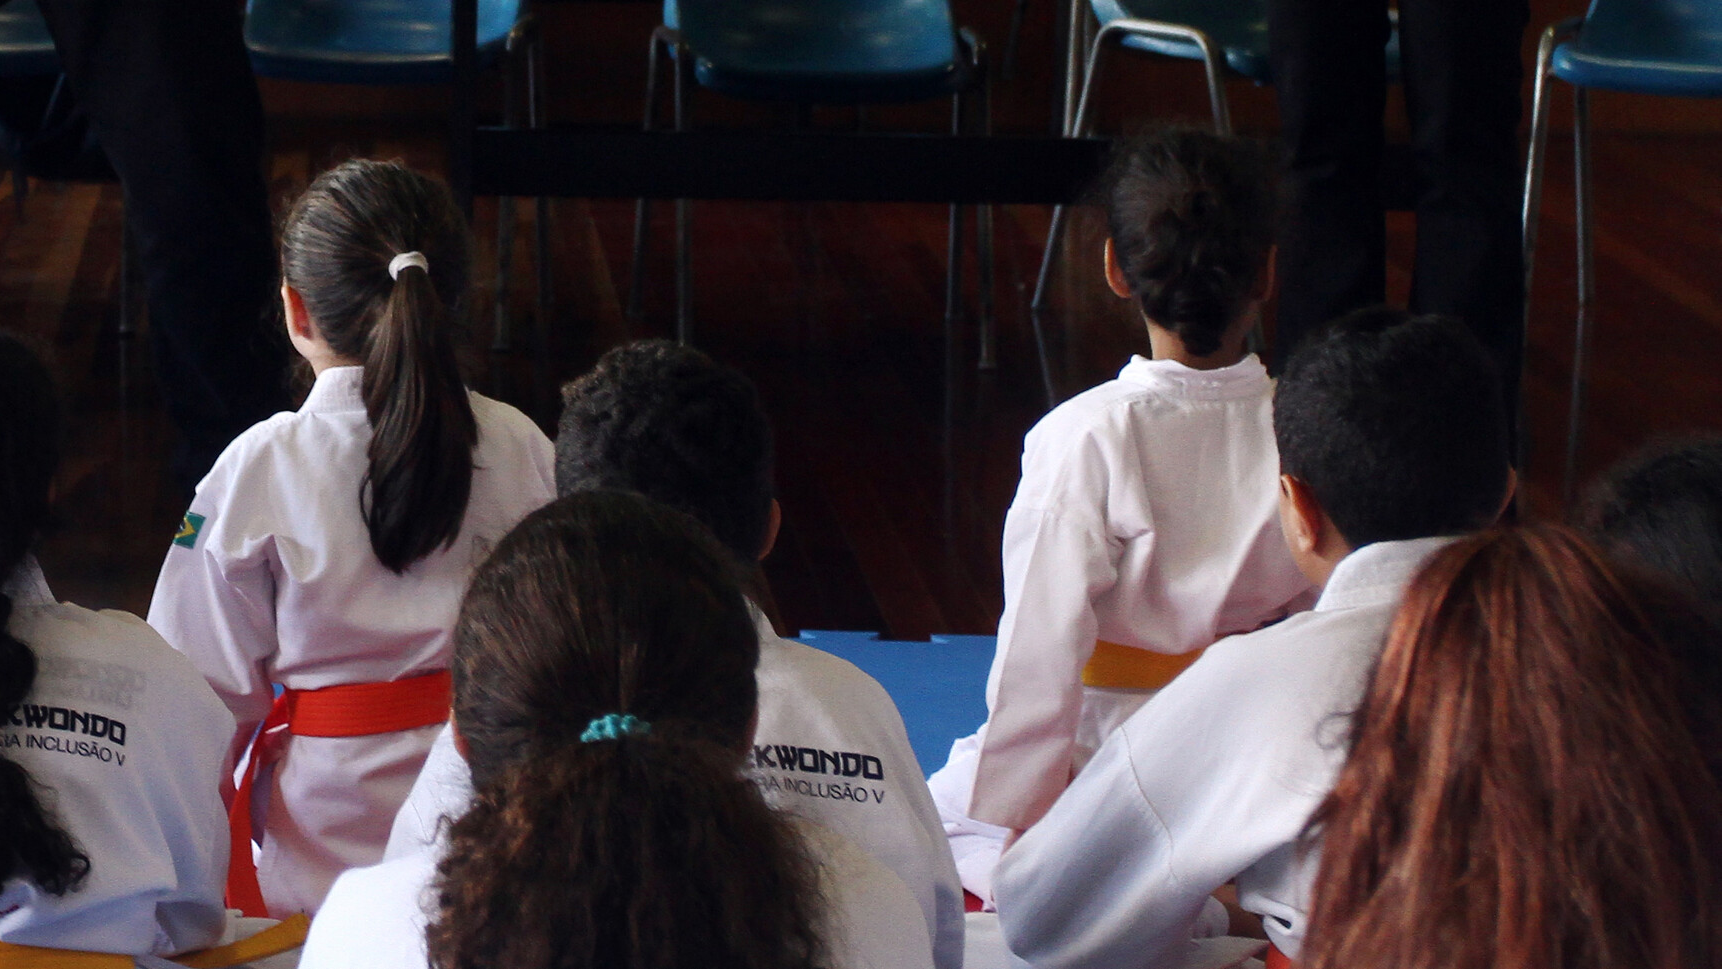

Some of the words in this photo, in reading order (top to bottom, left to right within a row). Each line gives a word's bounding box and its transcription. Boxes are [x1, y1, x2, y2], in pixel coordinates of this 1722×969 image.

[26, 734, 112, 763] INCLUSÃO
[115, 750, 127, 767] V
[784, 777, 869, 803] INCLUSÃO
[872, 788, 885, 804] V
